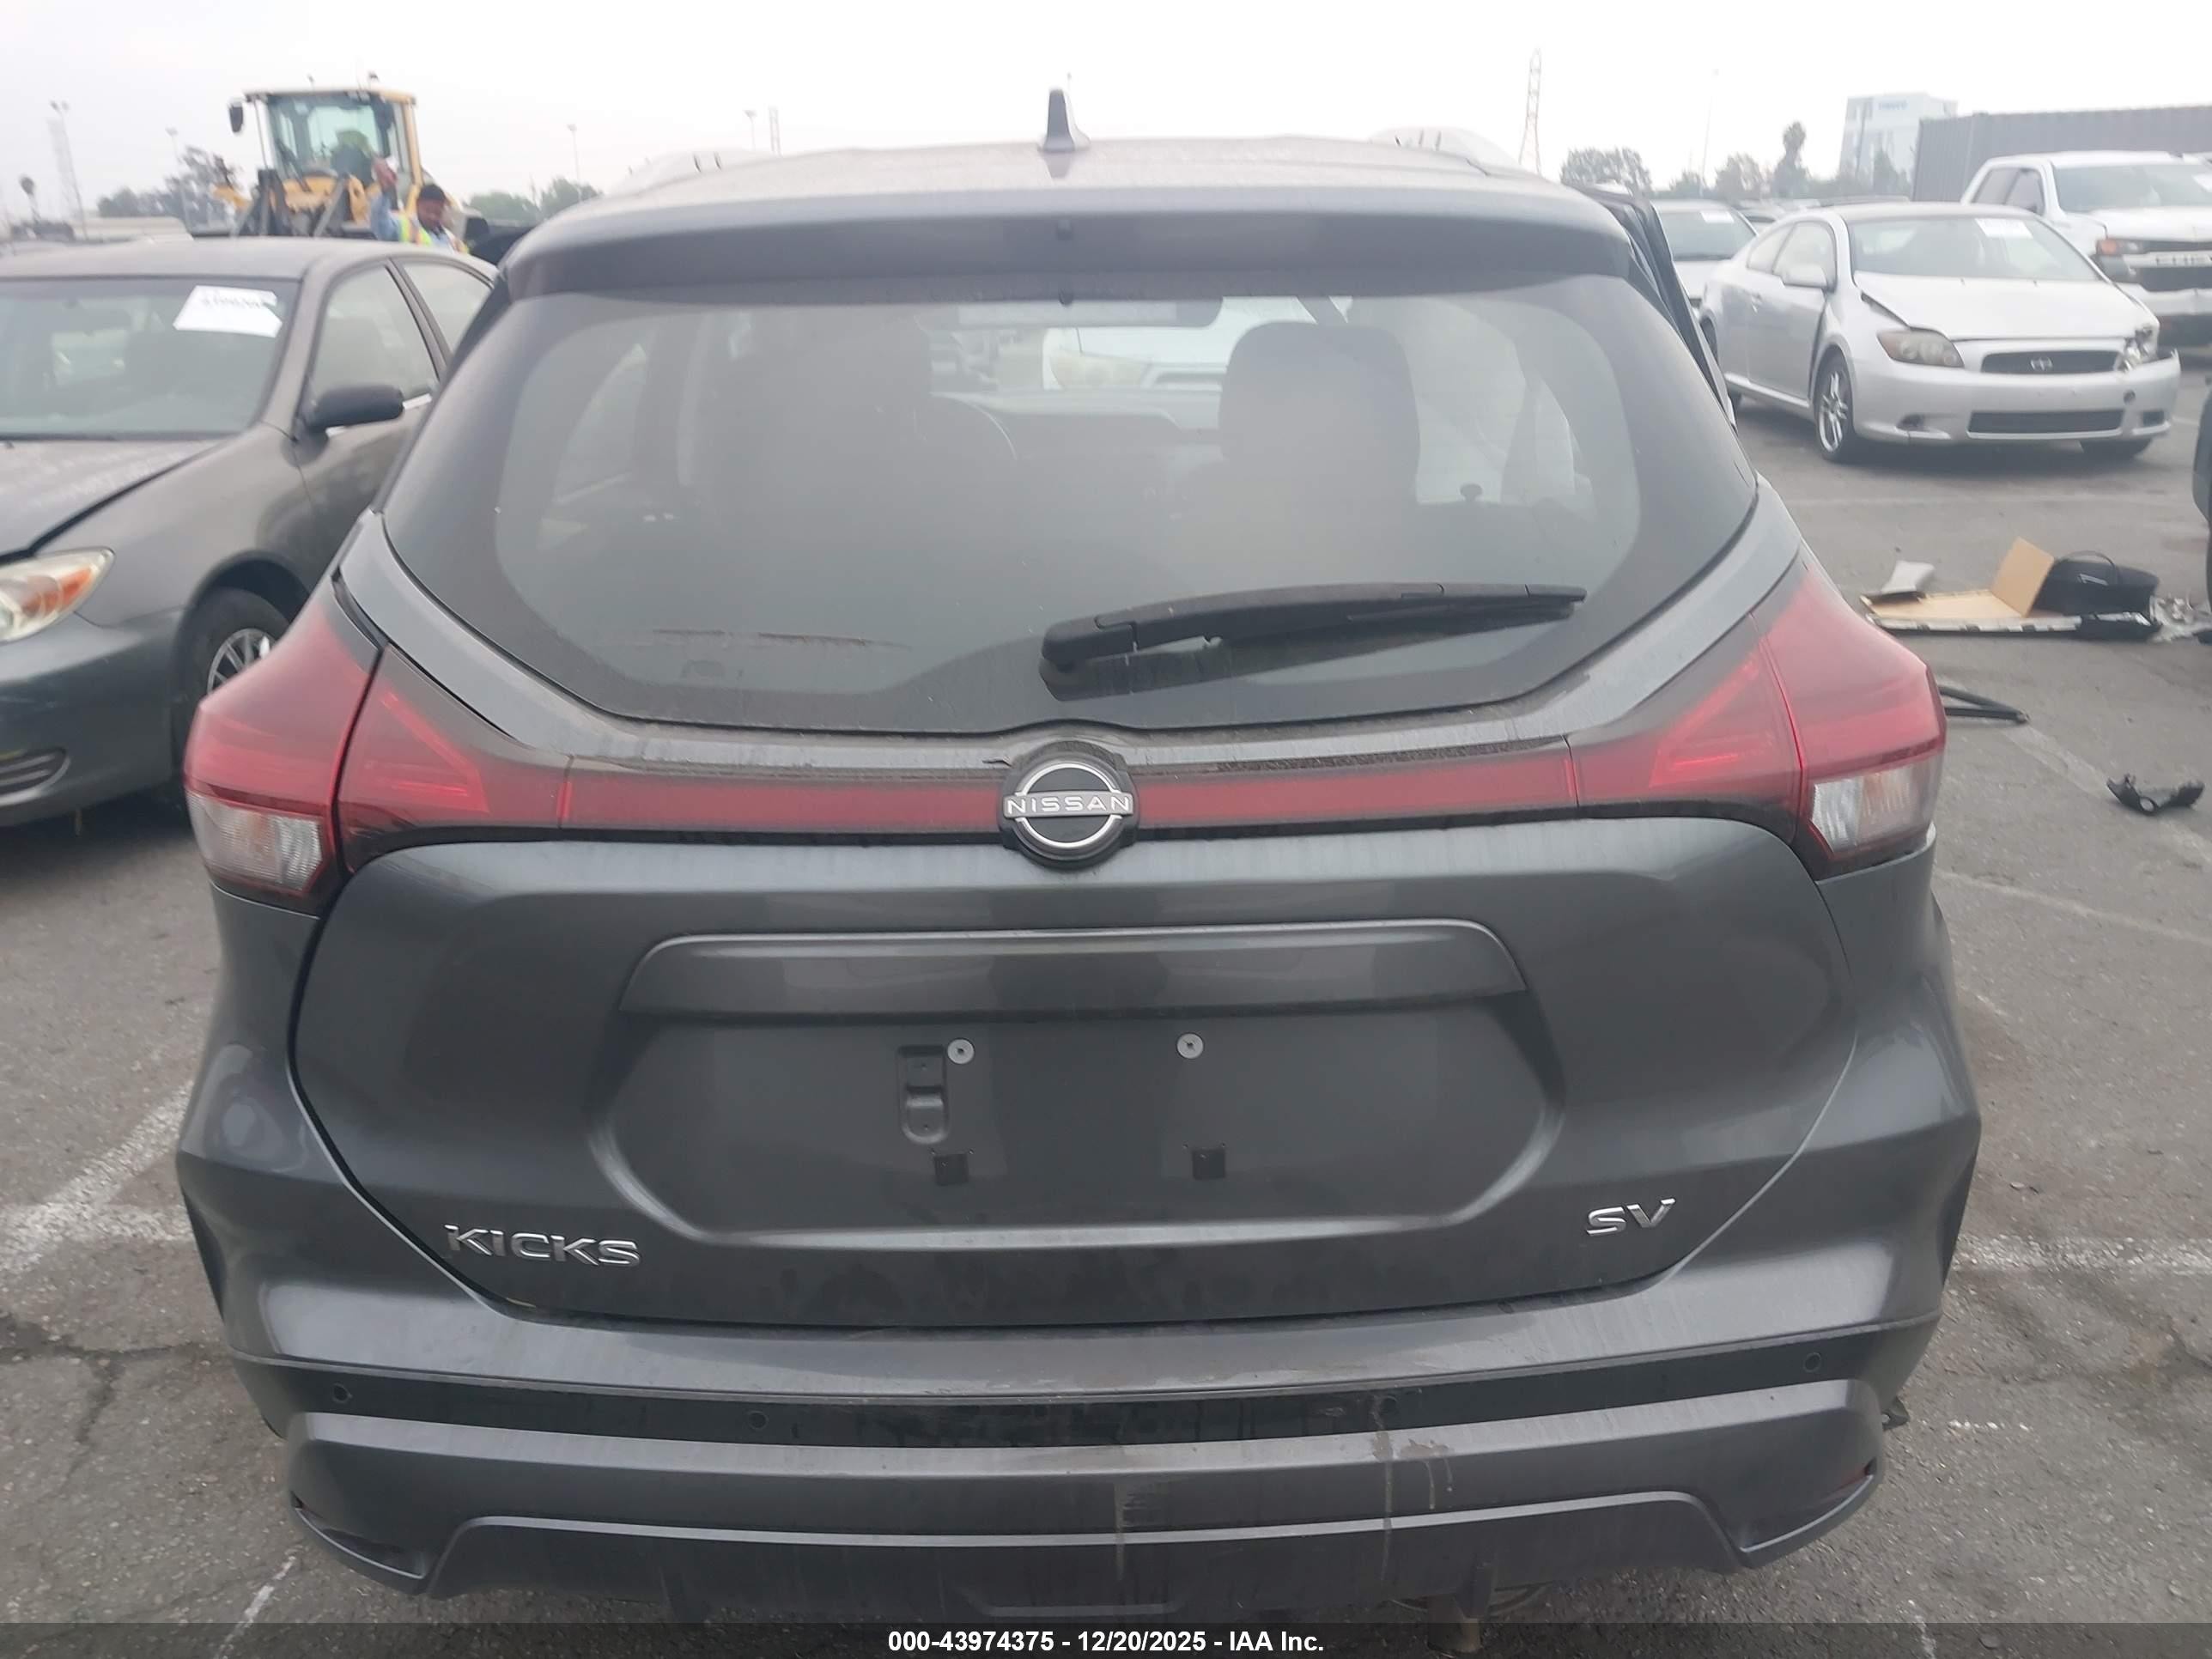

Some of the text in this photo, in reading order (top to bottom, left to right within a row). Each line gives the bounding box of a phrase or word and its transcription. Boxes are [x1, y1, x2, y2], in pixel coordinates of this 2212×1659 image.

[1006, 795, 1130, 815] NISSAN
[1586, 1198, 1675, 1237] SV
[444, 1224, 641, 1267] KICKS
